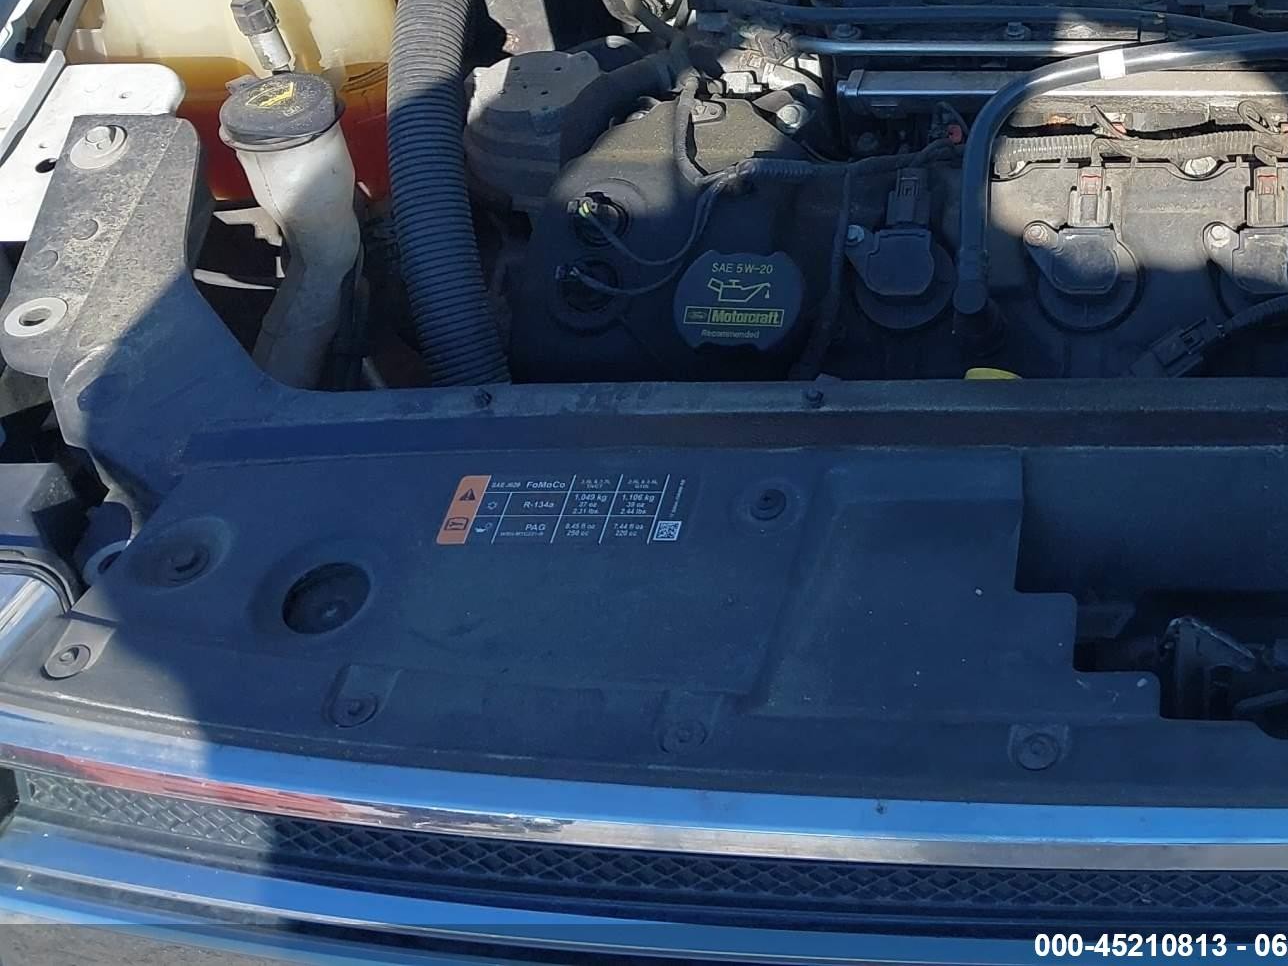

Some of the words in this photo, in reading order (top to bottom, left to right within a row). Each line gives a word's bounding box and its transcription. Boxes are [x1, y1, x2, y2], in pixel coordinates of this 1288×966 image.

[711, 262, 733, 273] SAE
[736, 263, 774, 275] 5W-20
[711, 309, 780, 325] Motorcraft
[701, 329, 761, 339] Recommended
[526, 480, 566, 489] FoMoCo
[596, 493, 608, 502] kg
[644, 493, 655, 502] kg
[523, 500, 555, 509] R-134a
[525, 523, 547, 531] PAG
